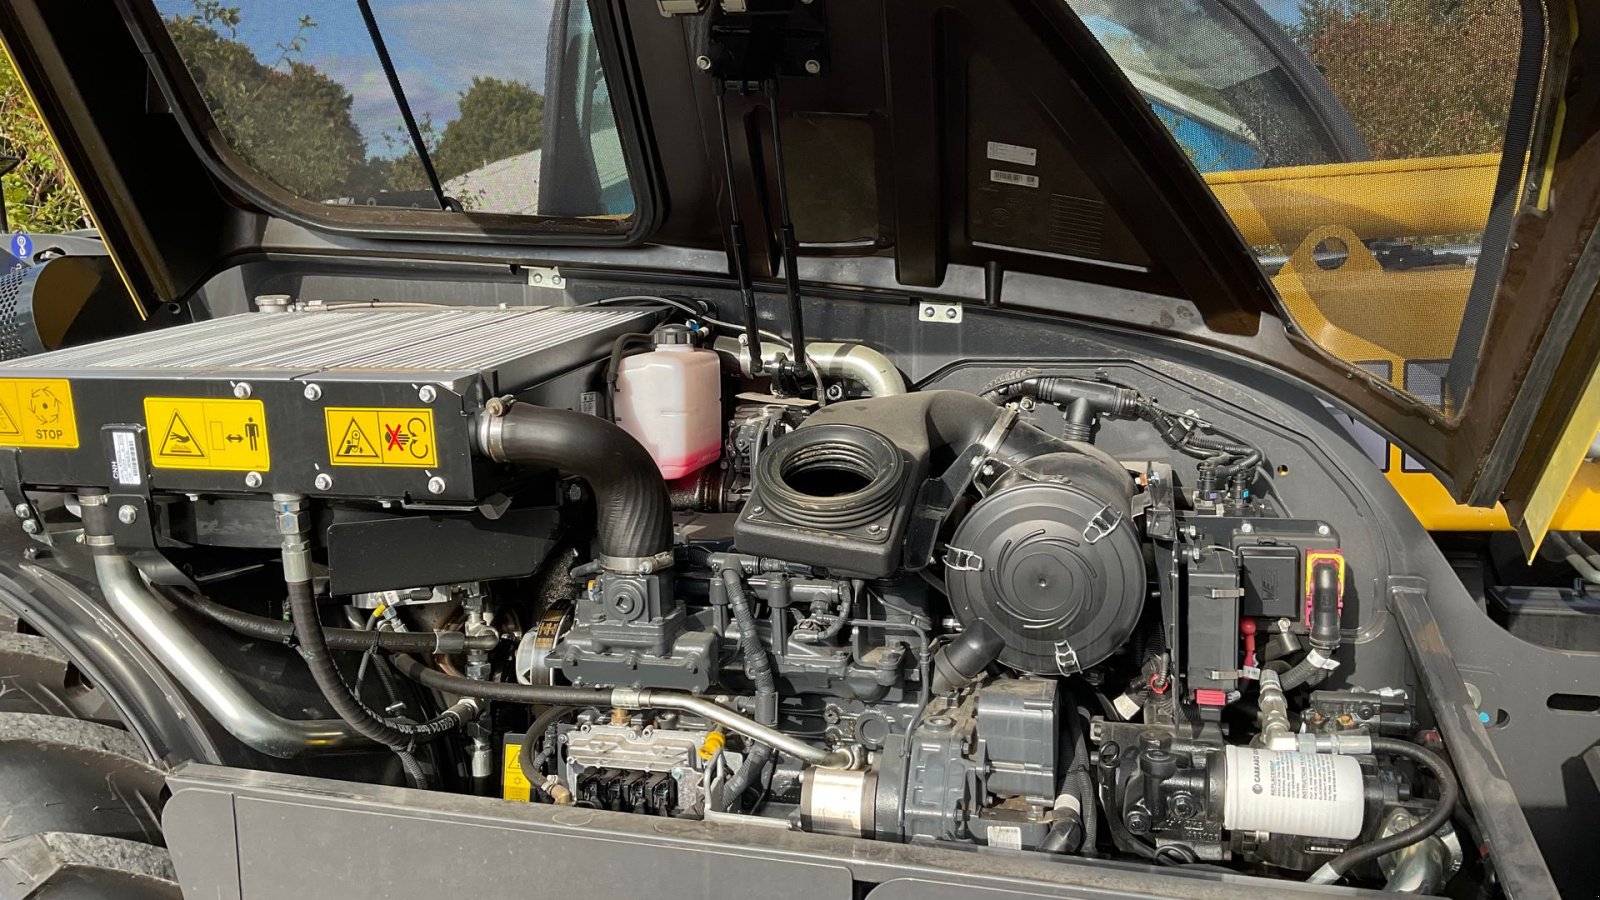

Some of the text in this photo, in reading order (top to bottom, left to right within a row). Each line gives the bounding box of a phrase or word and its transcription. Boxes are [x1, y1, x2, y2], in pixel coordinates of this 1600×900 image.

[36, 429, 63, 440] STOP
[111, 461, 119, 479] CNH
[1253, 756, 1261, 783] CARRARO
